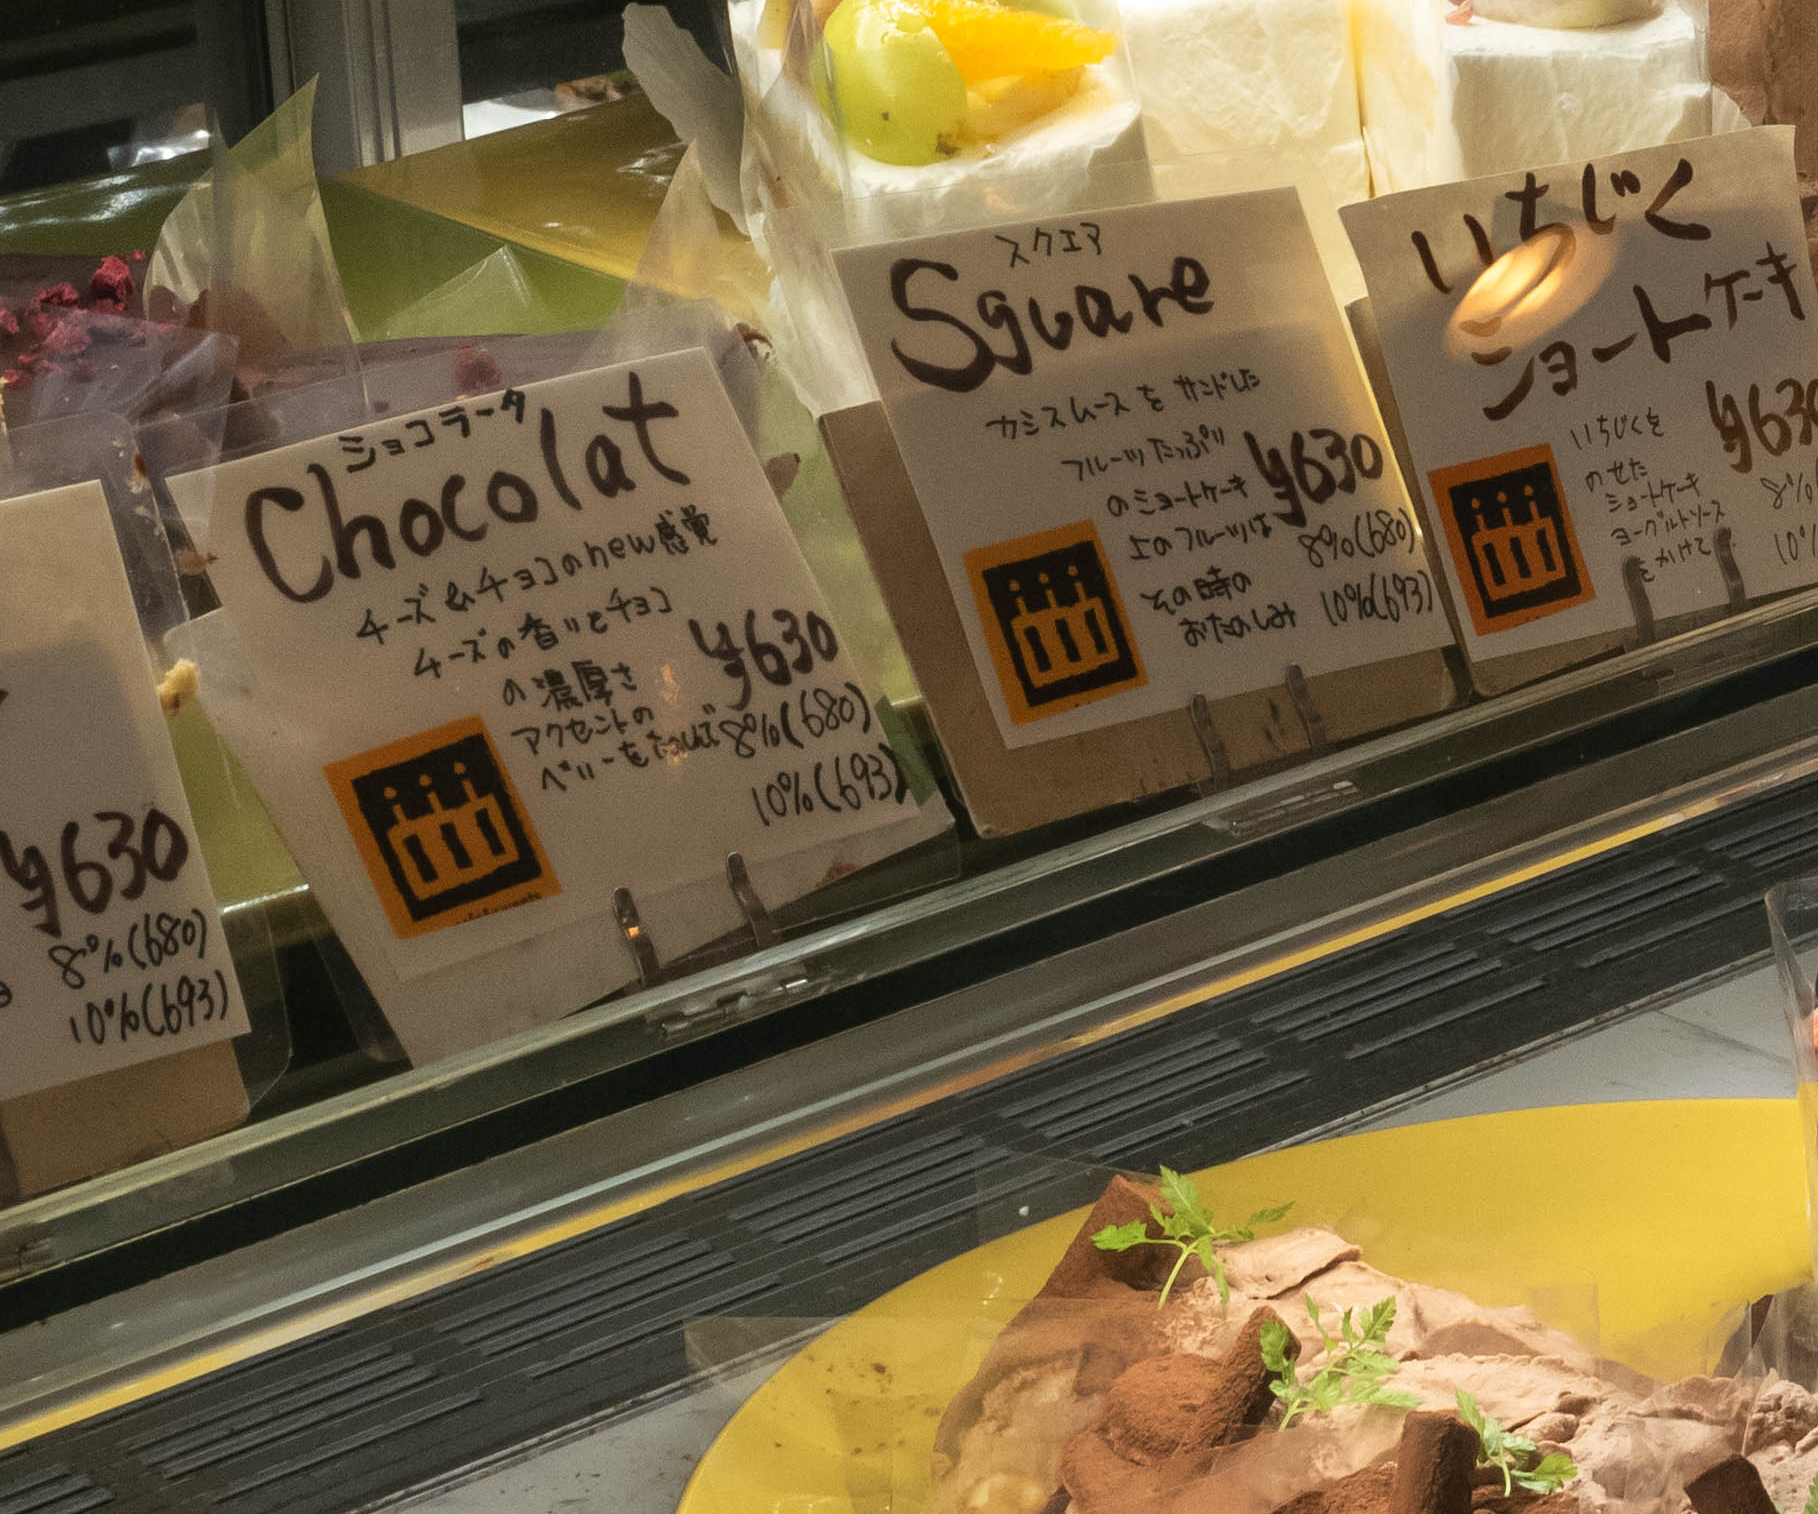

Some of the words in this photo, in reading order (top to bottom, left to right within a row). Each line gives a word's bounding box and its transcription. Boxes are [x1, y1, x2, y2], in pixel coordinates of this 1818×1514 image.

[994, 220, 1103, 269] スクエア
[1410, 157, 1713, 297] いちじく
[337, 387, 528, 474] ショコラータ
[1571, 406, 1666, 449] いちじくを
[244, 369, 693, 605] Chocolat
[1244, 428, 1383, 528] ¥630
[1585, 458, 1649, 493] のせた
[1300, 509, 1418, 569] 8%(680)
[1140, 565, 1253, 613] その時の
[1181, 604, 1298, 648] おたのしみ
[1319, 570, 1433, 628] 10%(693)
[687, 608, 841, 711] ¥630
[511, 703, 657, 756] アクセントの
[719, 683, 873, 758] 8%(680)
[752, 742, 907, 827] 10%(693)
[0, 807, 190, 939] ¥630
[48, 907, 208, 990] 8%(680)
[69, 969, 229, 1045] 10%(693)
